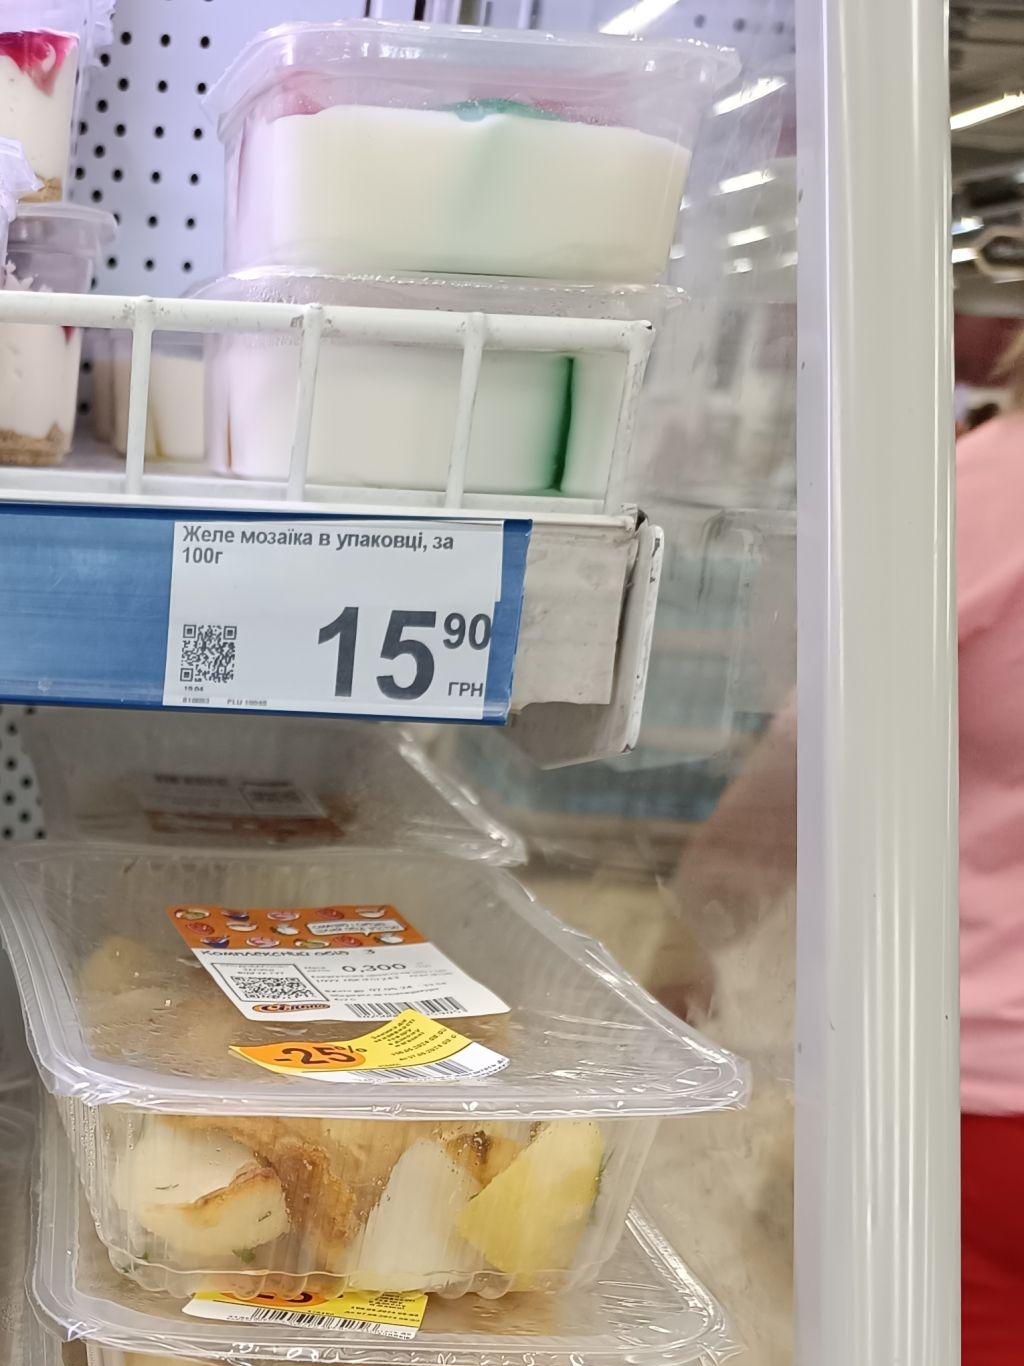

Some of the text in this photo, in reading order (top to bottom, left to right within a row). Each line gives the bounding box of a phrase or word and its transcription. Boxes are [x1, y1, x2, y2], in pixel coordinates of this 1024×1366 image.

[182, 525, 454, 552] Желе мозаїка в упаковці, за
[182, 547, 224, 565] 100г
[317, 606, 493, 701] 15 90
[447, 681, 484, 698] ГРН
[342, 962, 407, 973] 0,300
[273, 1045, 368, 1067] -25%
